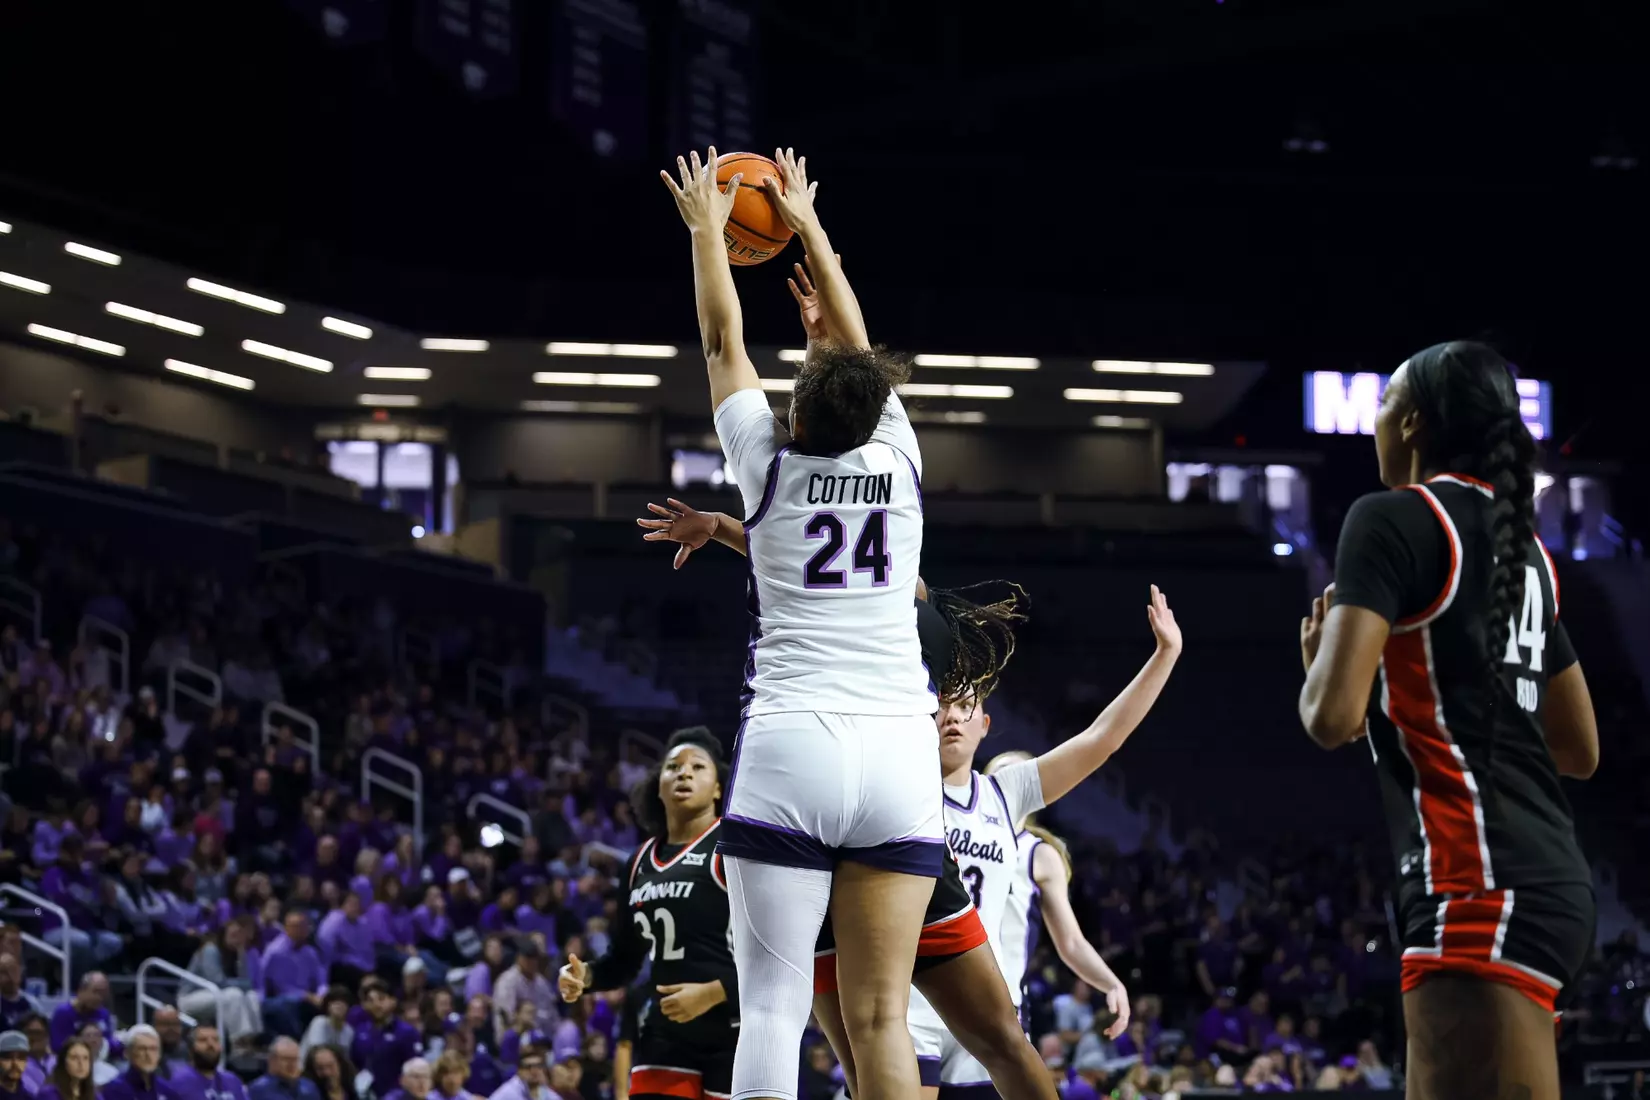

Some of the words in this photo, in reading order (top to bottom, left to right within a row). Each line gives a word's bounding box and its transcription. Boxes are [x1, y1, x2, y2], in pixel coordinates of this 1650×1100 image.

[807, 473, 892, 505] COTTON
[804, 509, 892, 589] 24
[634, 907, 685, 962] 32
